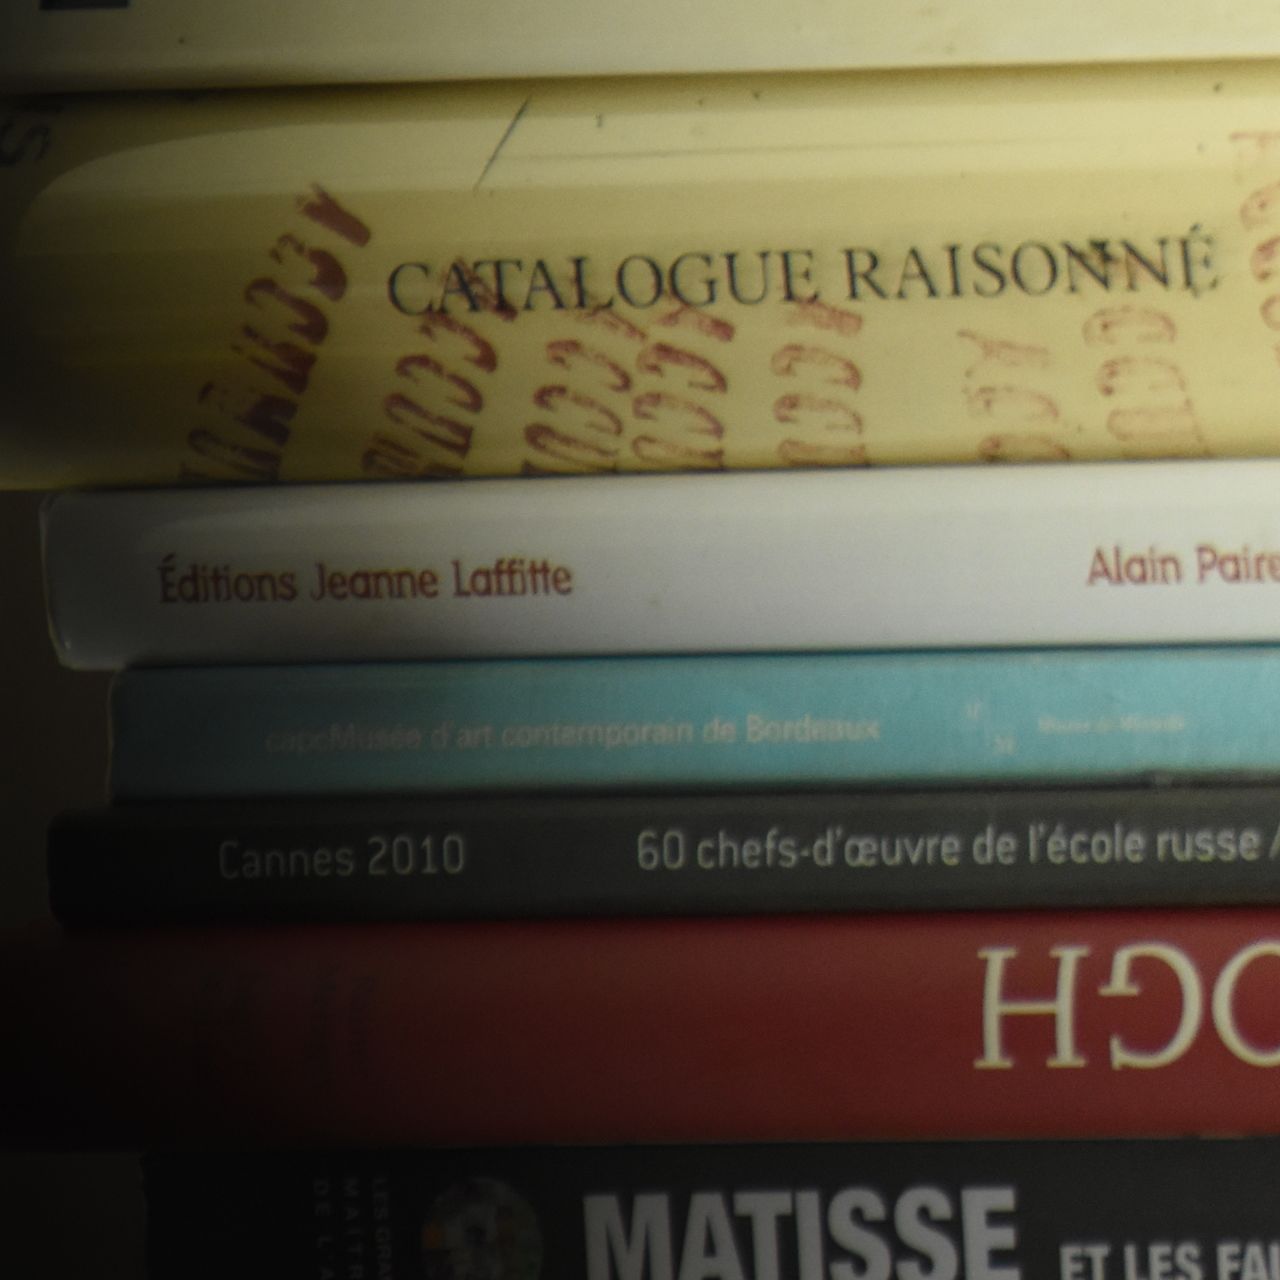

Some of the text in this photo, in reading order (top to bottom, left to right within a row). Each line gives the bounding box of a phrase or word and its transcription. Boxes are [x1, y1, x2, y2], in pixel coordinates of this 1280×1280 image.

[387, 246, 821, 317] CATALOGUE
[842, 223, 1220, 303] RAISONNÉ
[156, 552, 573, 605] Éditions Jeanne Laffitte
[1086, 543, 1182, 588] Alain
[501, 716, 693, 753] contemporain
[702, 715, 737, 746] de
[745, 710, 882, 744] Bordeaux
[218, 831, 468, 880] Cannes 2010
[636, 828, 686, 871] 60
[971, 825, 1017, 866] de
[1028, 821, 1145, 865] l'école
[1156, 828, 1258, 864] russe
[584, 1185, 1020, 1280] MATISSE
[1059, 1241, 1111, 1280] ET
[1124, 1240, 1202, 1280] LES
